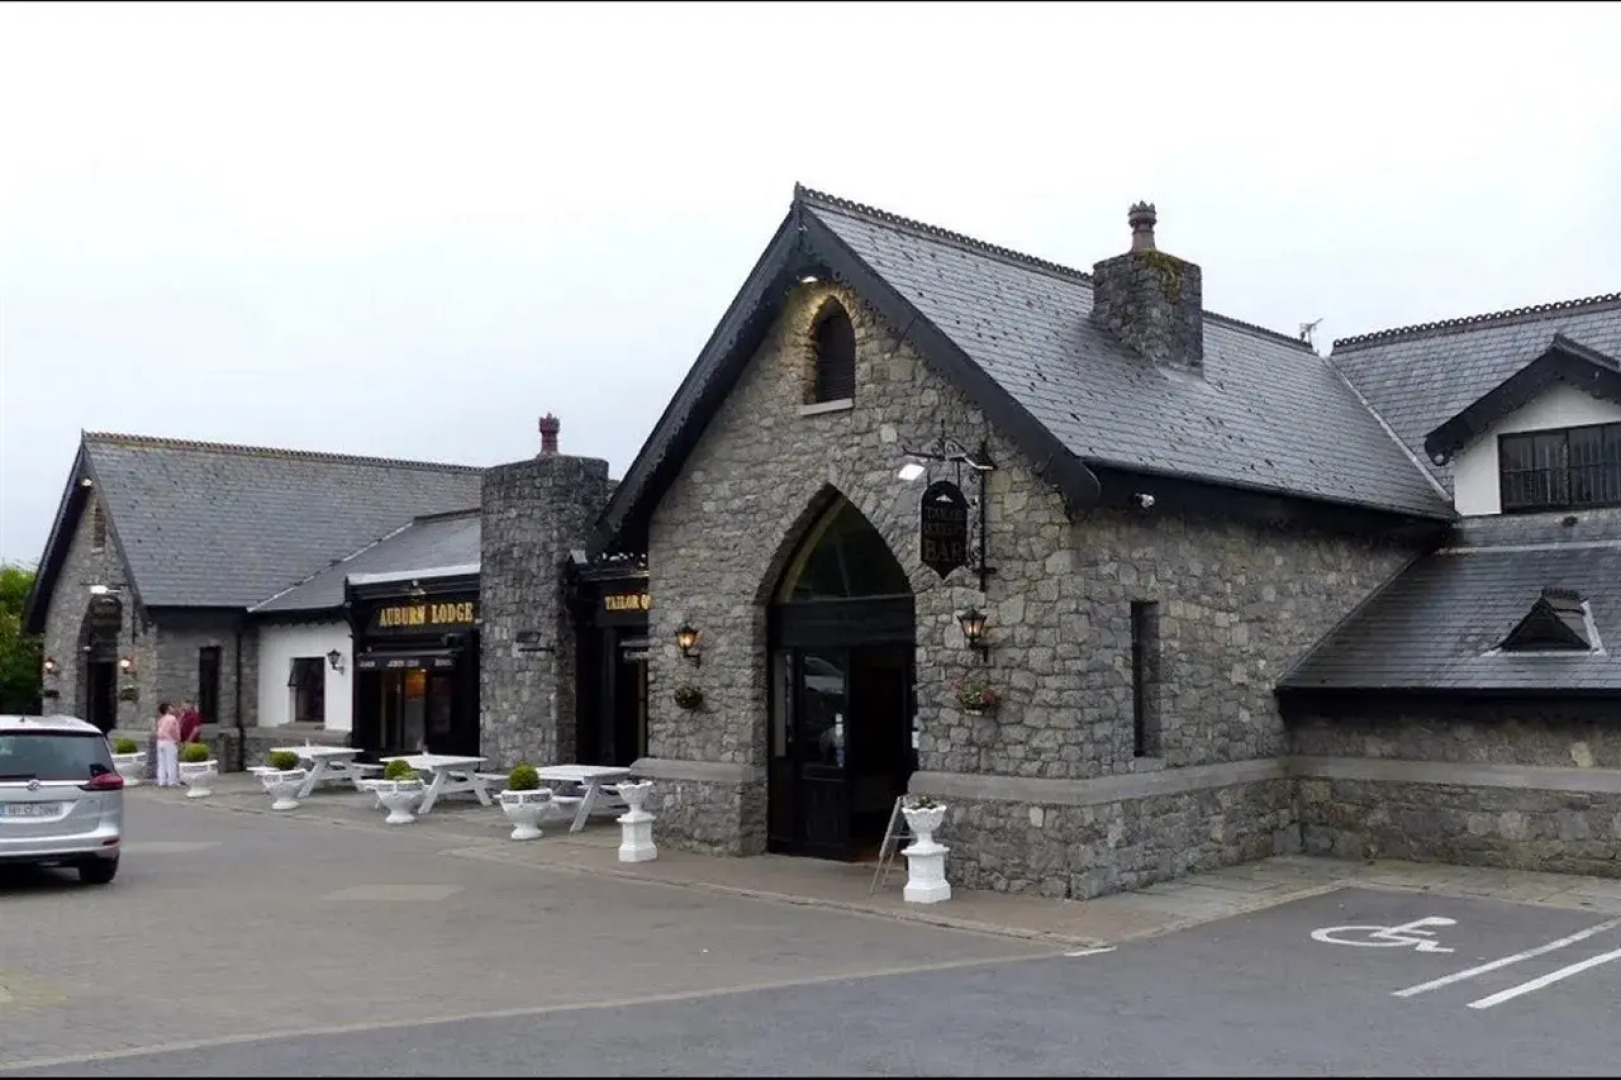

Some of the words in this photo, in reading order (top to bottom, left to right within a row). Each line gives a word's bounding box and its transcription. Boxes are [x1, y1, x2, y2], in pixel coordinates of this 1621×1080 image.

[924, 539, 963, 562] BAR
[604, 595, 640, 609] TAILOR
[380, 606, 425, 628] AUBURN
[432, 603, 473, 623] LODGE
